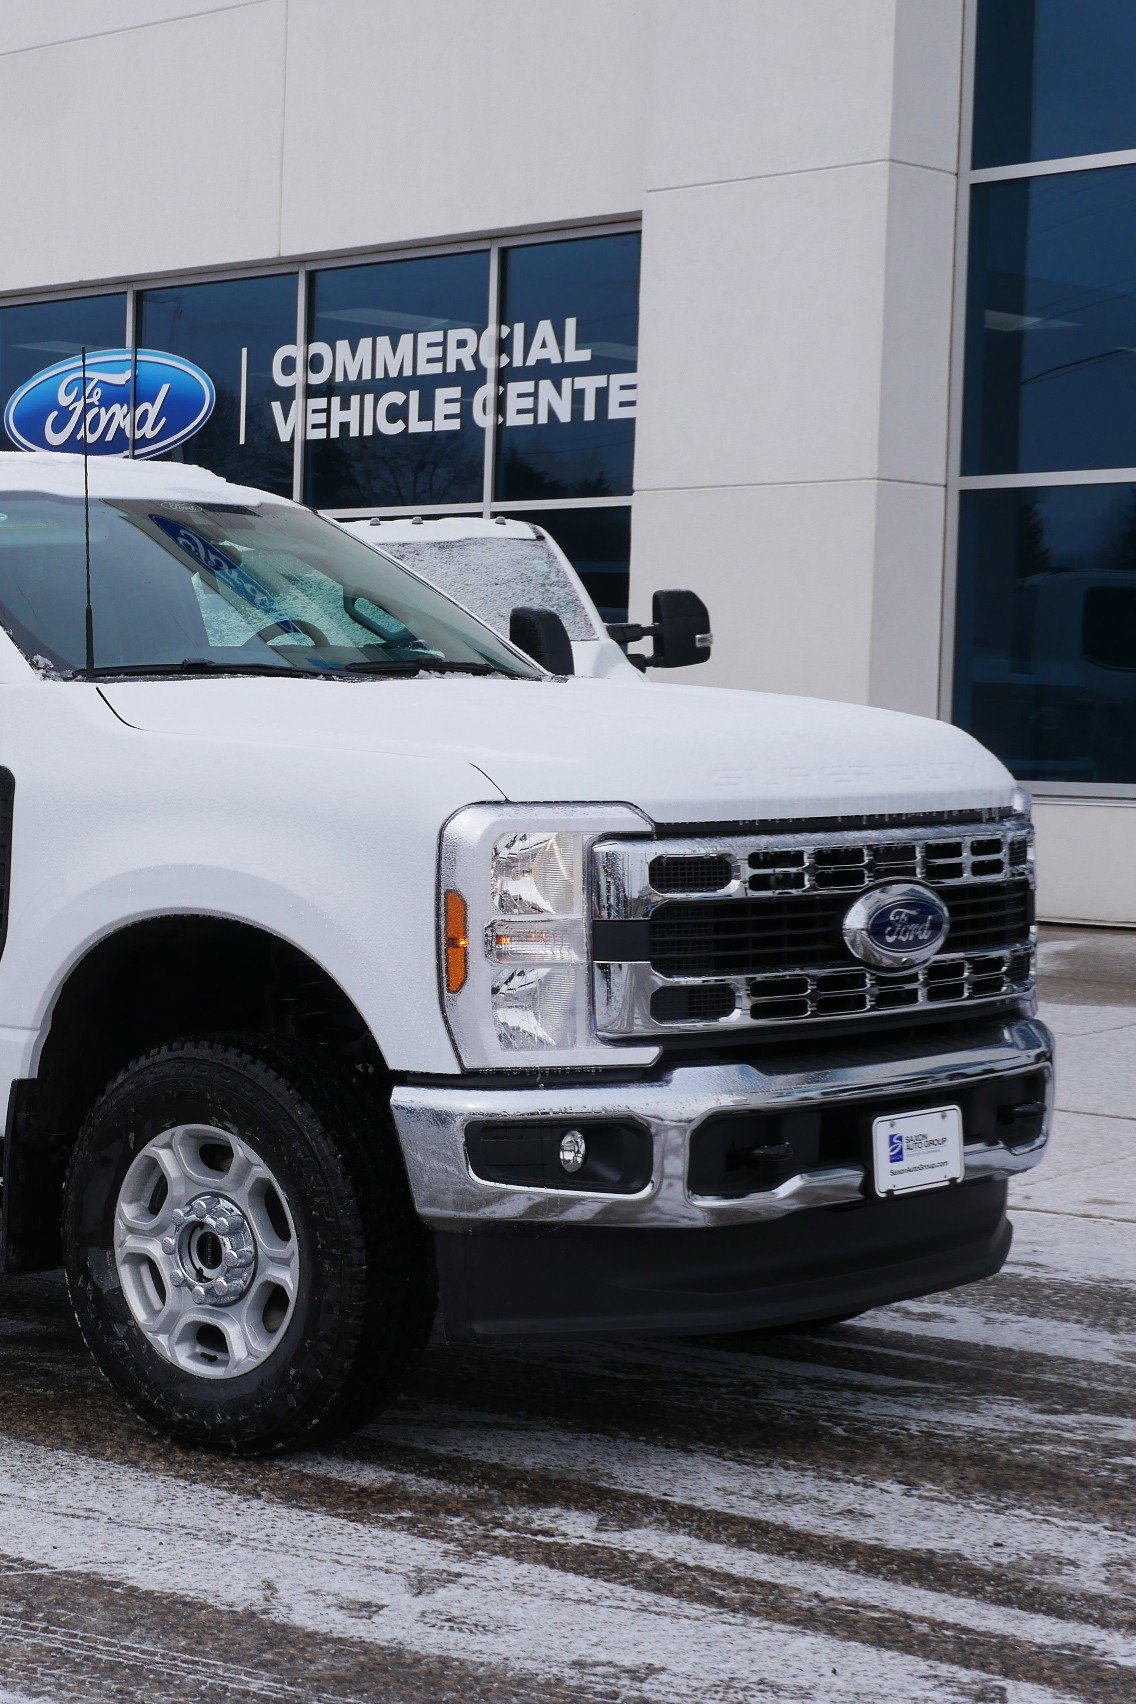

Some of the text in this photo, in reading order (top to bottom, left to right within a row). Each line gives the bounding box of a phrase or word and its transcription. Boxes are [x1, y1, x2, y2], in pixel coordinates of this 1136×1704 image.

[272, 317, 592, 388] COMMERCIAL
[44, 368, 171, 446] Ford
[271, 387, 462, 442] VEHICLE
[885, 907, 933, 943] Ford
[905, 1134, 927, 1144] SAXON
[906, 1137, 947, 1150] AUTO GROUP
